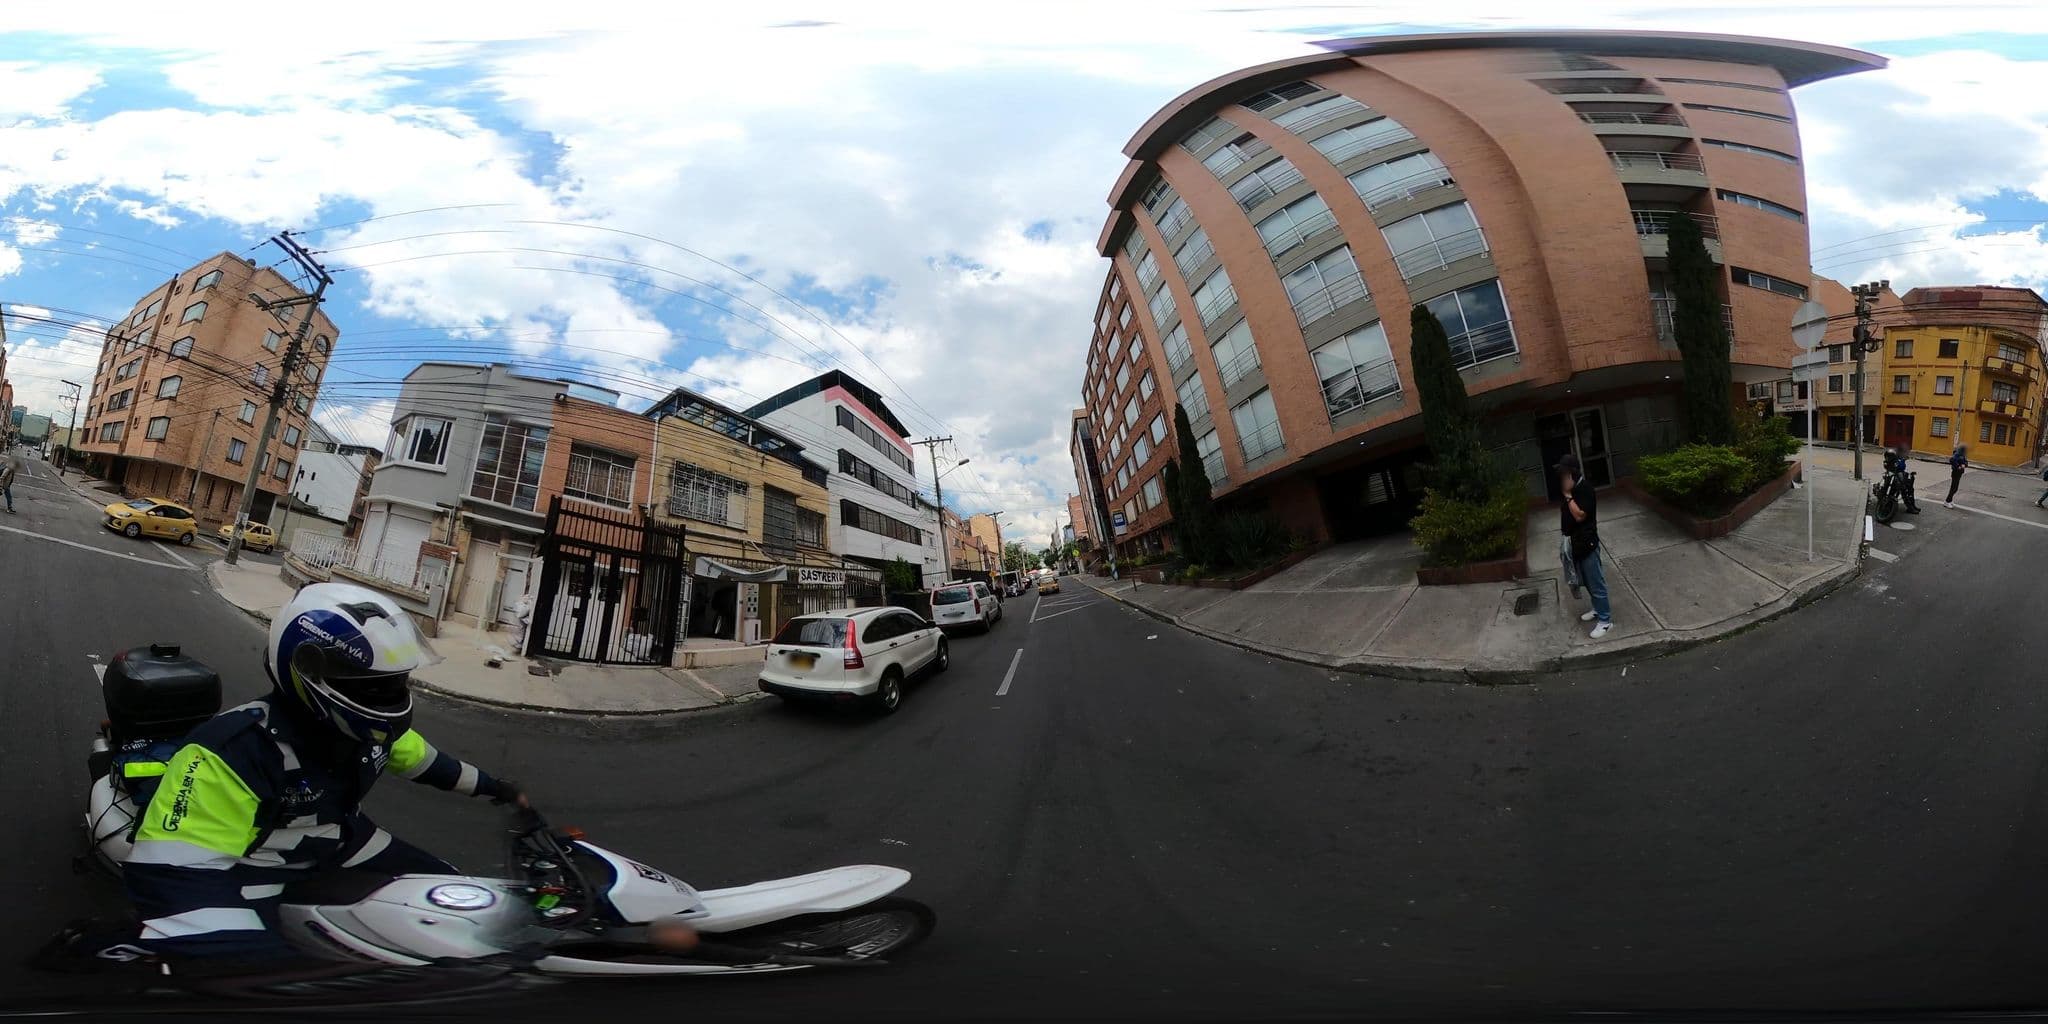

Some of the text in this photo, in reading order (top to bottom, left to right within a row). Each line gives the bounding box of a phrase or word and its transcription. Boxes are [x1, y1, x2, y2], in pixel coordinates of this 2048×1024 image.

[298, 615, 334, 643] GERENCIA
[335, 639, 348, 651] EN
[162, 789, 187, 832] GERENCIA
[183, 775, 191, 787] EN
